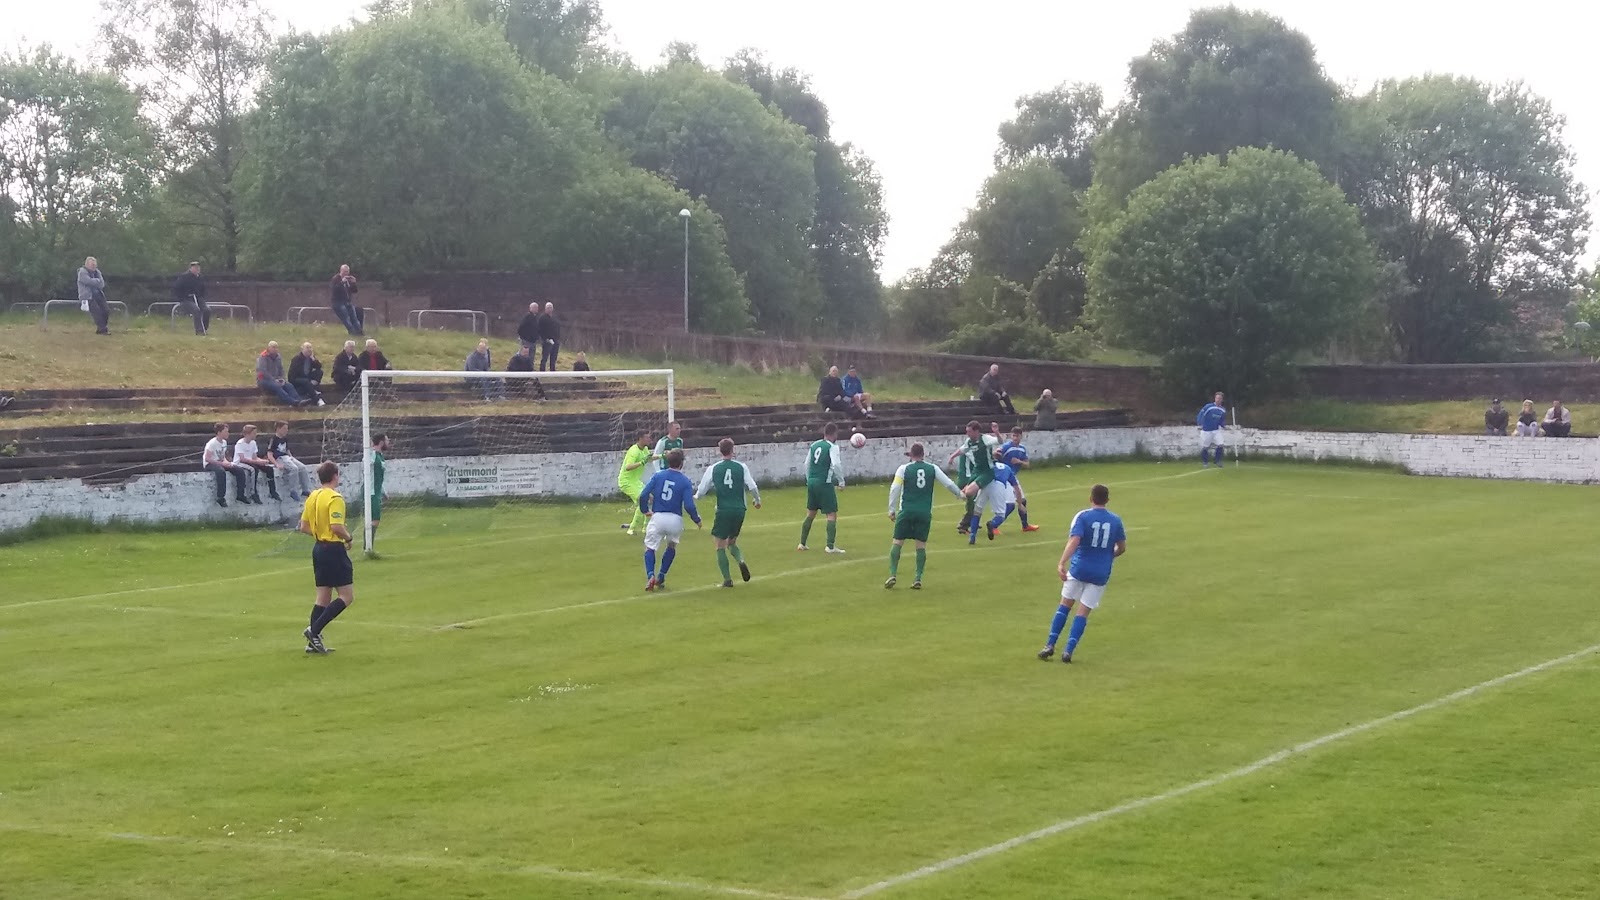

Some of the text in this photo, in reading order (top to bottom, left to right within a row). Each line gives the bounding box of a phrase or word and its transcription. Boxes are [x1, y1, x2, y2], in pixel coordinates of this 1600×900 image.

[814, 446, 822, 464] 9
[447, 466, 498, 477] drummond
[723, 468, 734, 489] 4
[916, 468, 926, 489] 8
[661, 480, 675, 501] 5
[1091, 521, 1111, 549] 11
